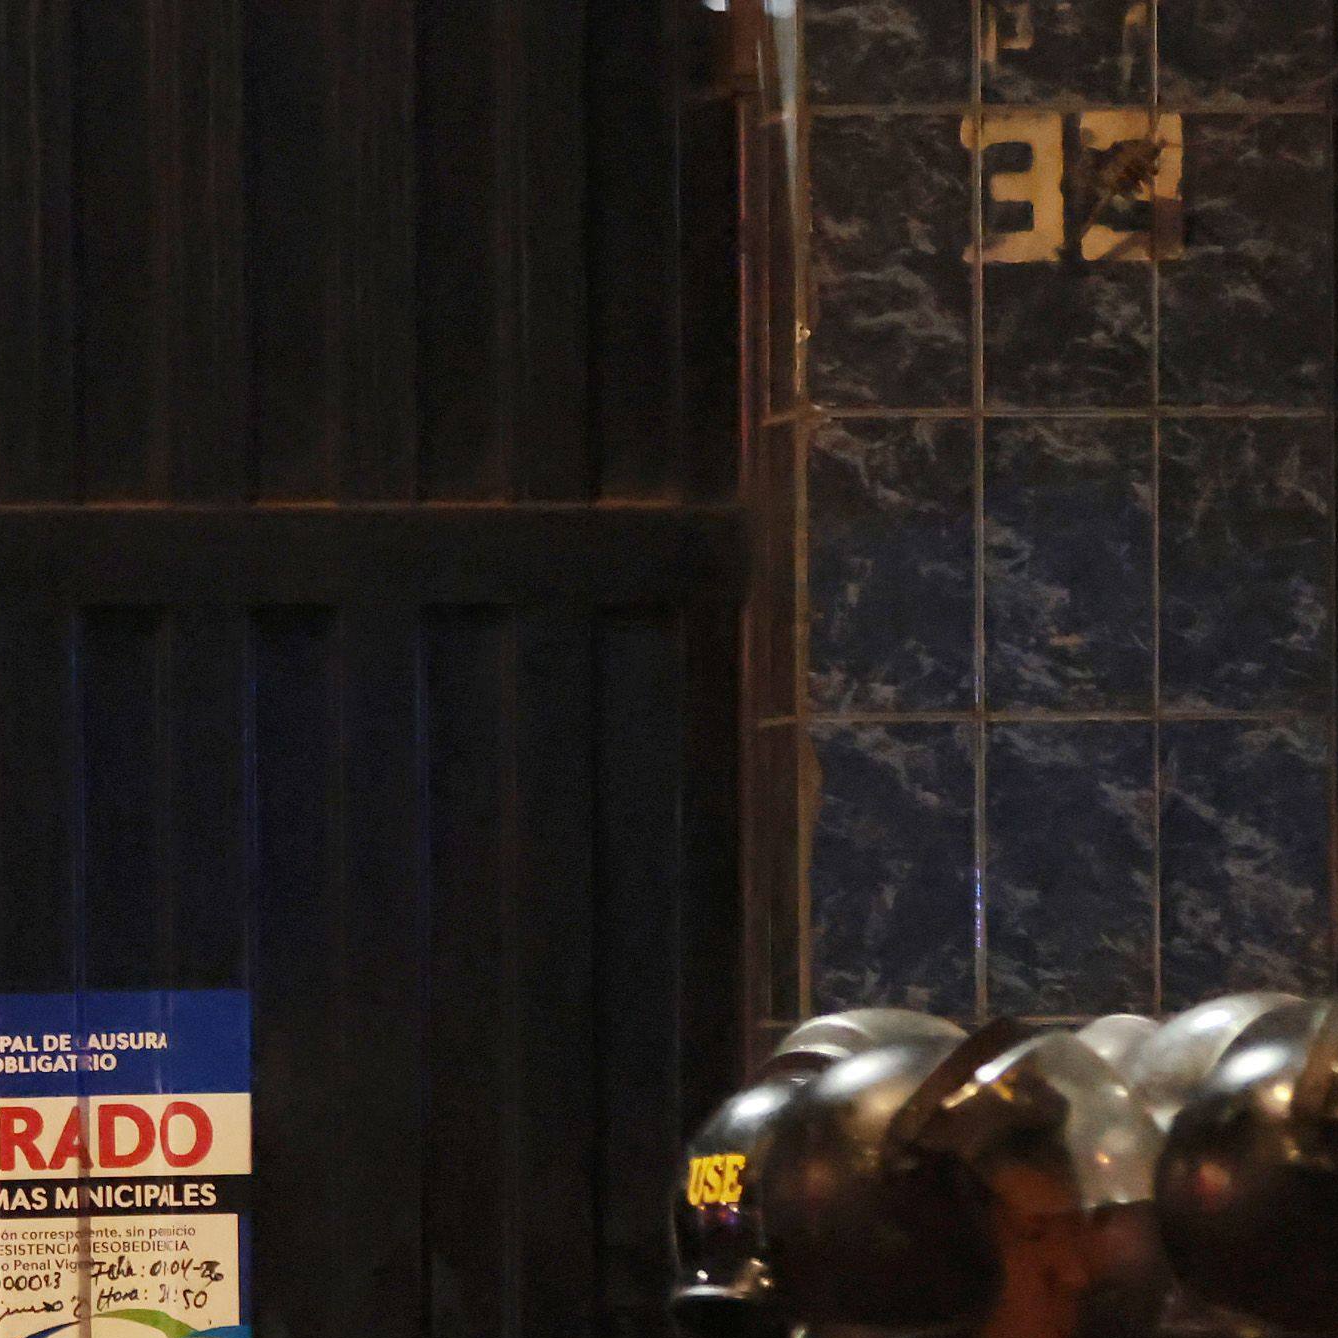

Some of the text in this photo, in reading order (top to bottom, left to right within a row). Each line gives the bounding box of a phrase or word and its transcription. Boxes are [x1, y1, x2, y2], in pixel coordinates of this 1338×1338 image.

[42, 1034, 72, 1052] DE
[79, 1031, 168, 1052] AUSURA
[688, 1153, 746, 1206] USE
[55, 1183, 217, 1210] MNICIPALES
[125, 1226, 145, 1239] sin
[14, 1257, 51, 1271] Penal
